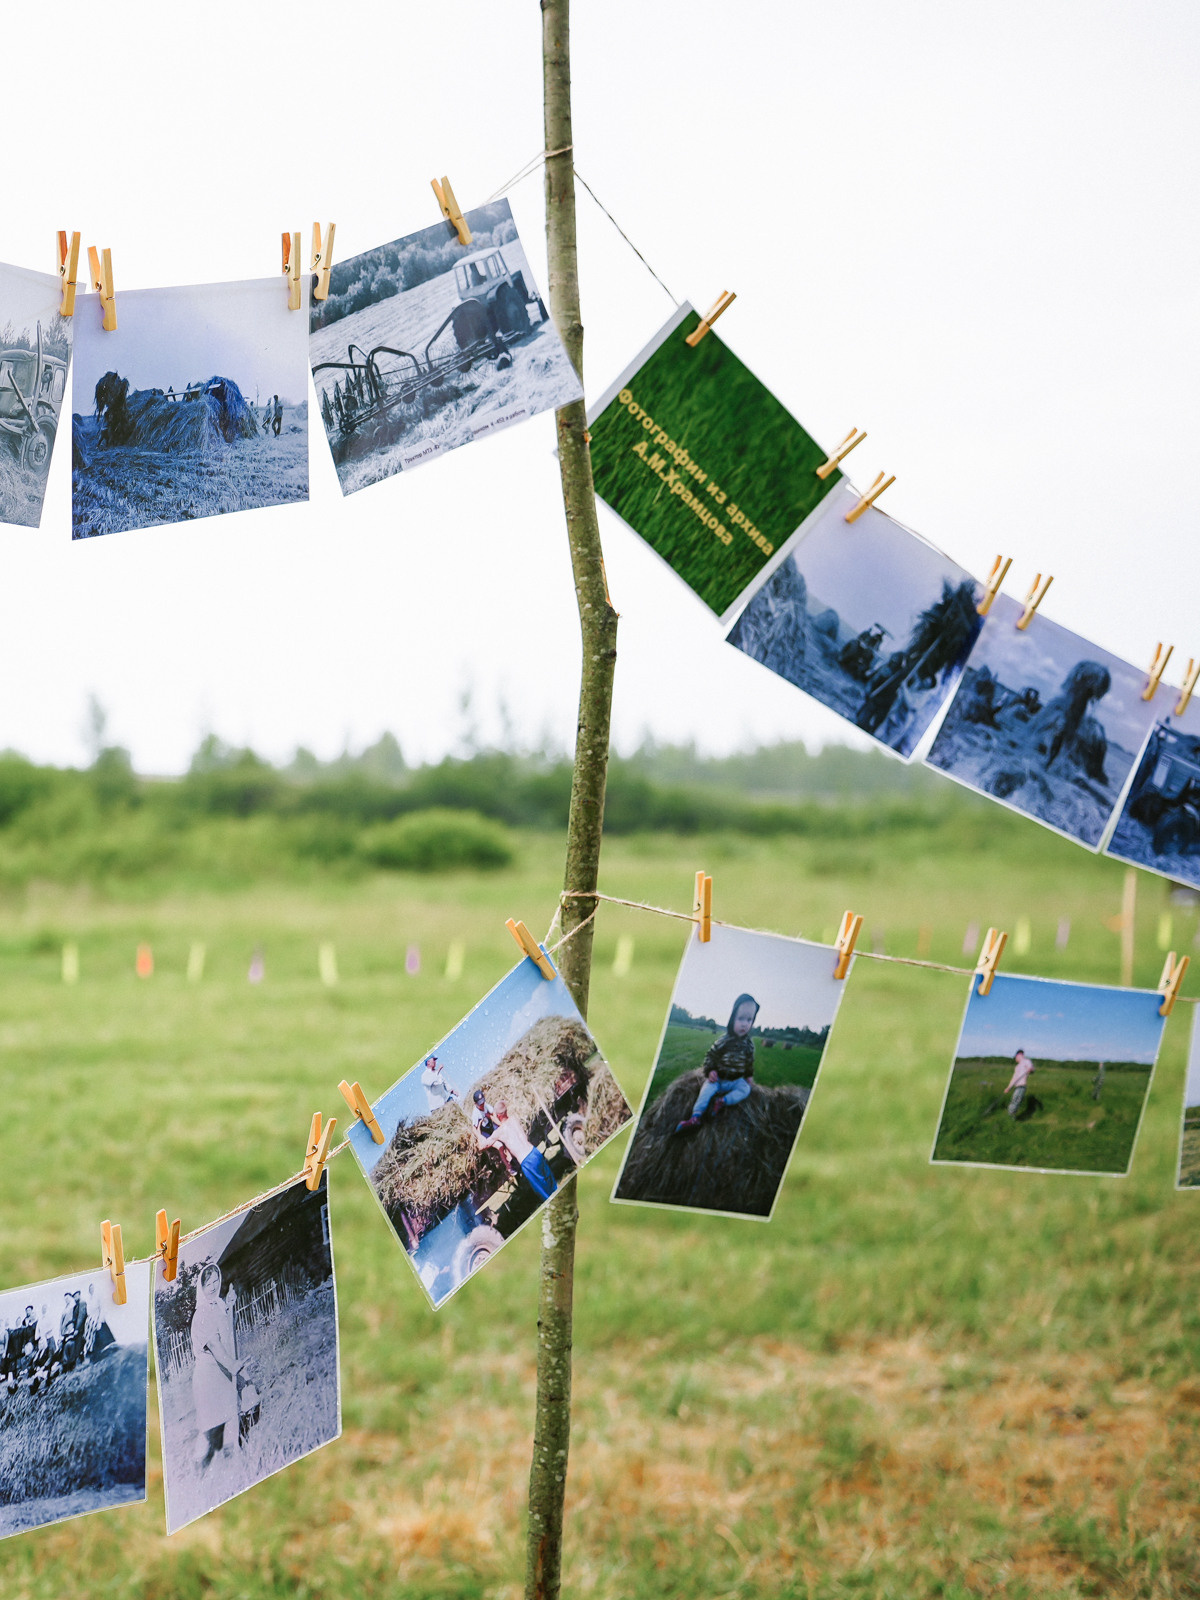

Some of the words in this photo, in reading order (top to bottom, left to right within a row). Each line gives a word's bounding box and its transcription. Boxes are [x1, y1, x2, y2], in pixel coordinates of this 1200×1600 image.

[618, 388, 708, 484] Фотографии
[706, 481, 728, 505] из
[725, 503, 774, 557] архива
